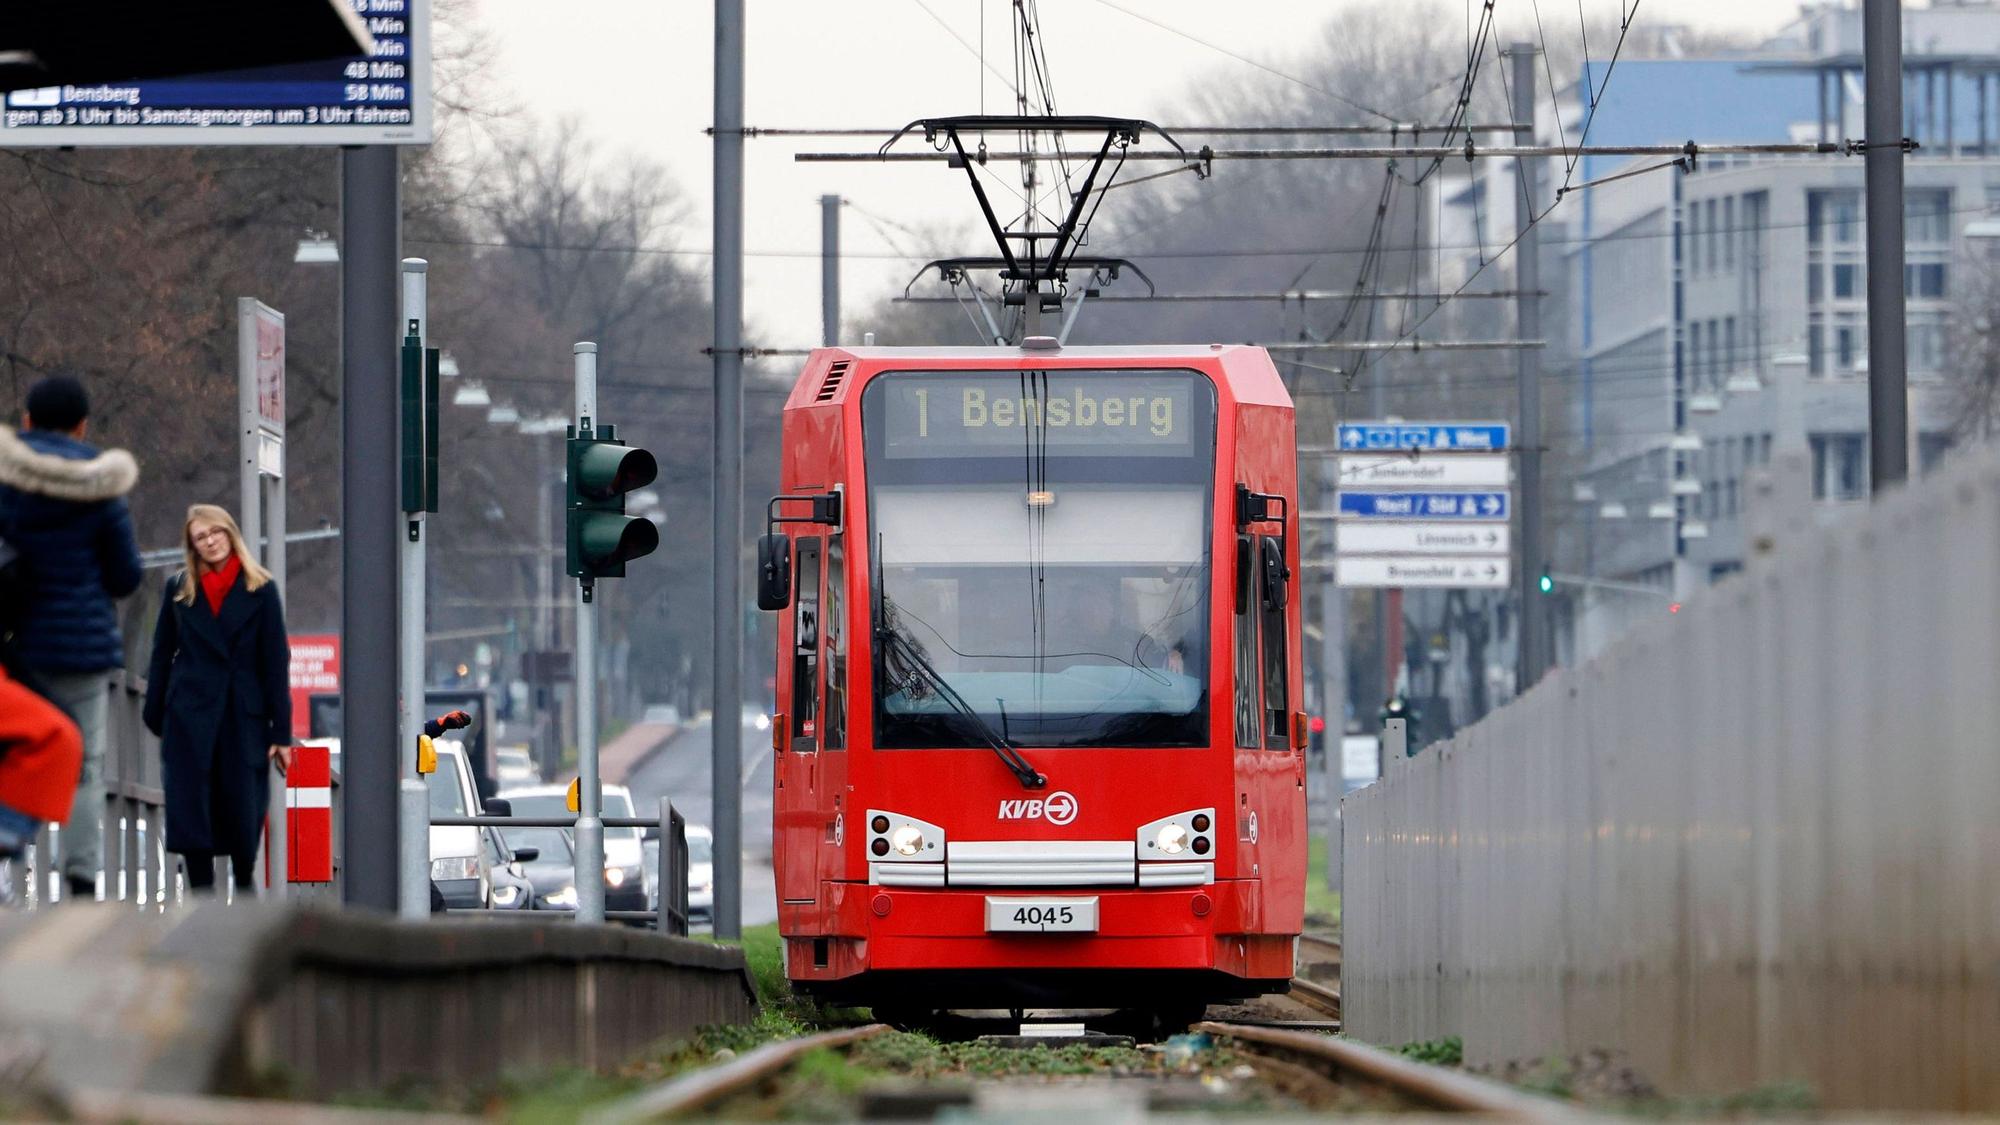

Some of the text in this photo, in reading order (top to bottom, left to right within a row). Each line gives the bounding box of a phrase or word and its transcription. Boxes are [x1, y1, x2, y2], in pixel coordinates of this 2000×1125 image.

[369, 0, 405, 12] Min
[369, 17, 405, 34] Min
[372, 39, 405, 56] Min
[344, 61, 405, 79] 48 Min
[62, 85, 140, 104] Bensberg
[344, 84, 368, 101] 58
[369, 84, 405, 101] Min
[6, 106, 410, 127] gen ab 3 Uhr bis Samstagmorgen um 3 Uhr fahren
[915, 387, 1173, 437] 1 Bensberg
[998, 799, 1043, 819] KVB
[1013, 906, 1074, 925] 4045
